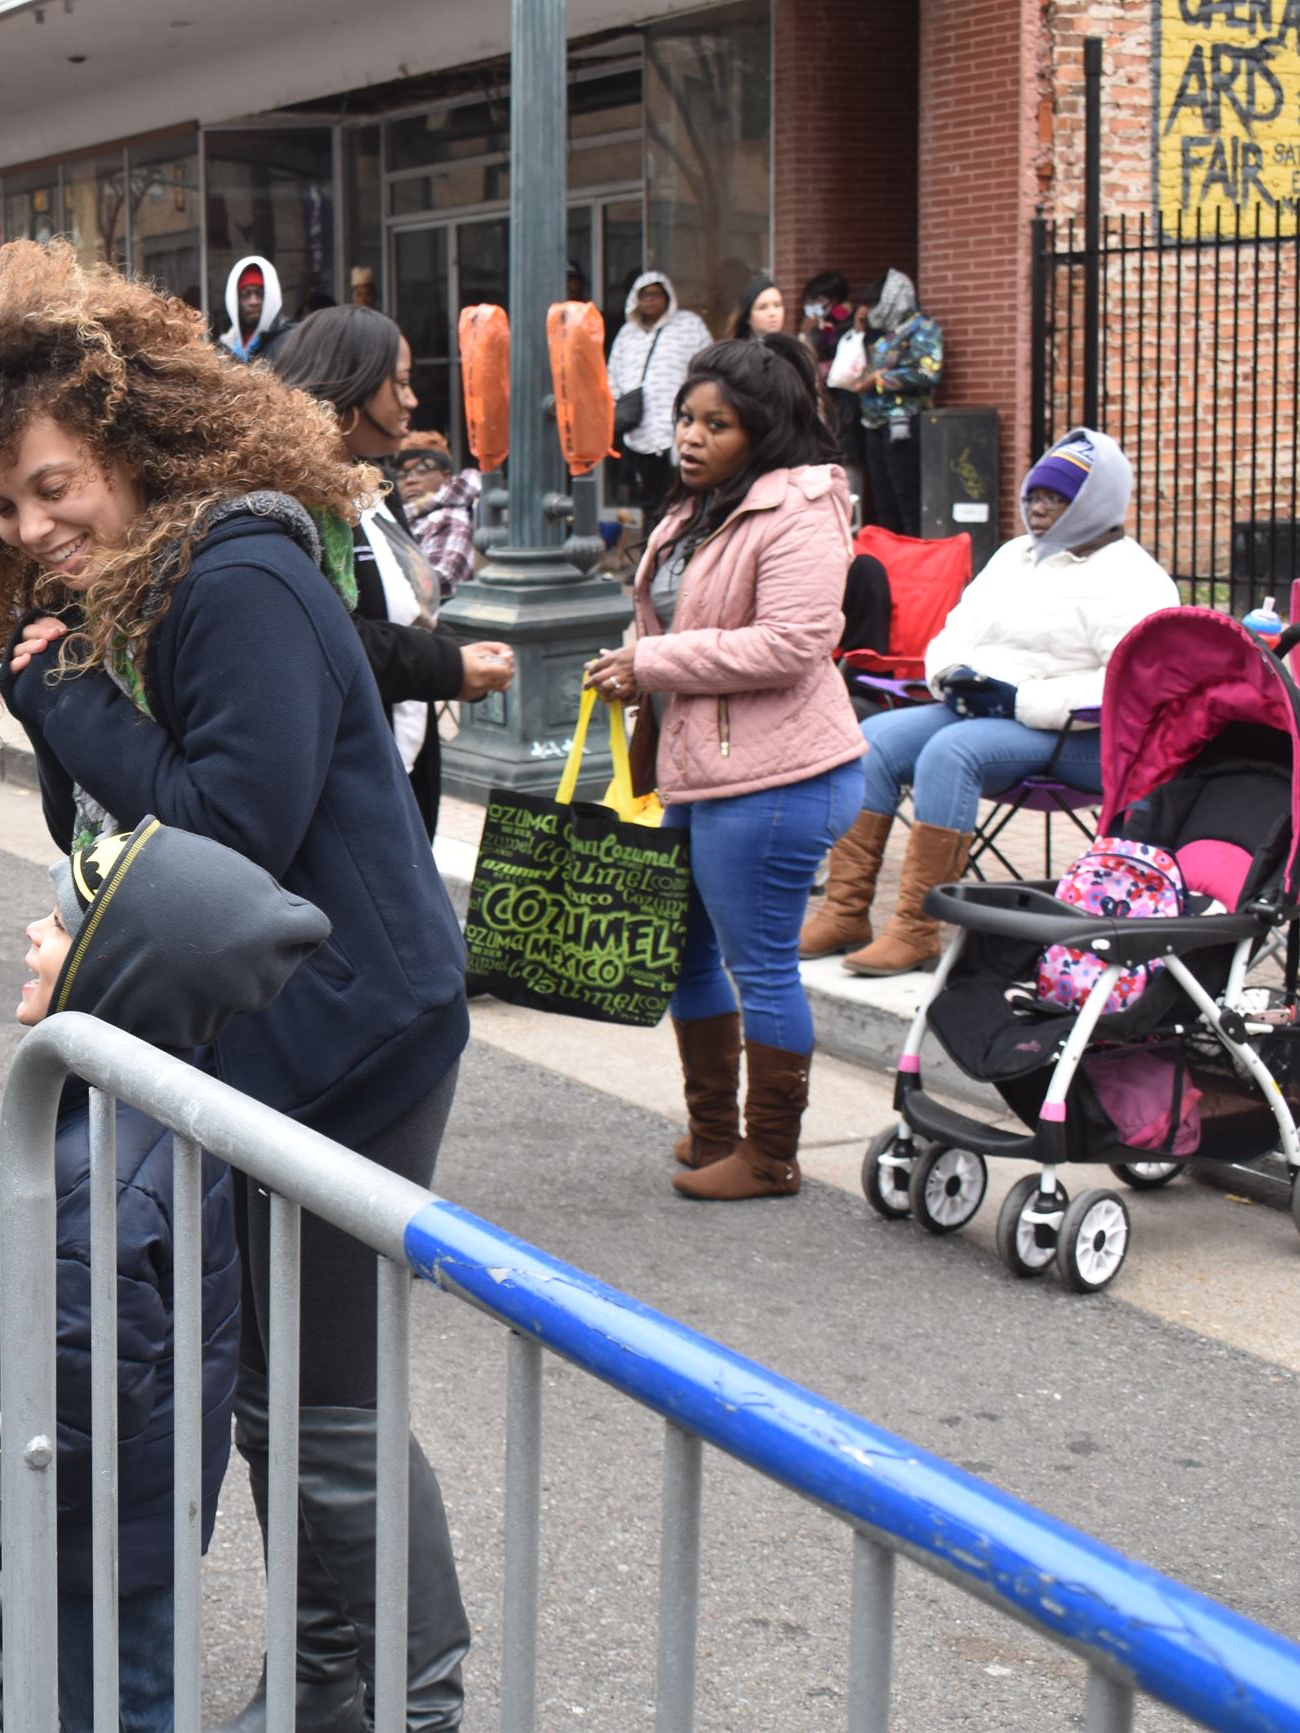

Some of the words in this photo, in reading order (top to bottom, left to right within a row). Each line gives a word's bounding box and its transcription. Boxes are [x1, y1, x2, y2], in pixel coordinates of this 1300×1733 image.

[1181, 134, 1276, 214] FAIR
[600, 833, 681, 869] Cozumel
[482, 882, 679, 969] COZUMEL
[524, 932, 625, 989] MEXICO
